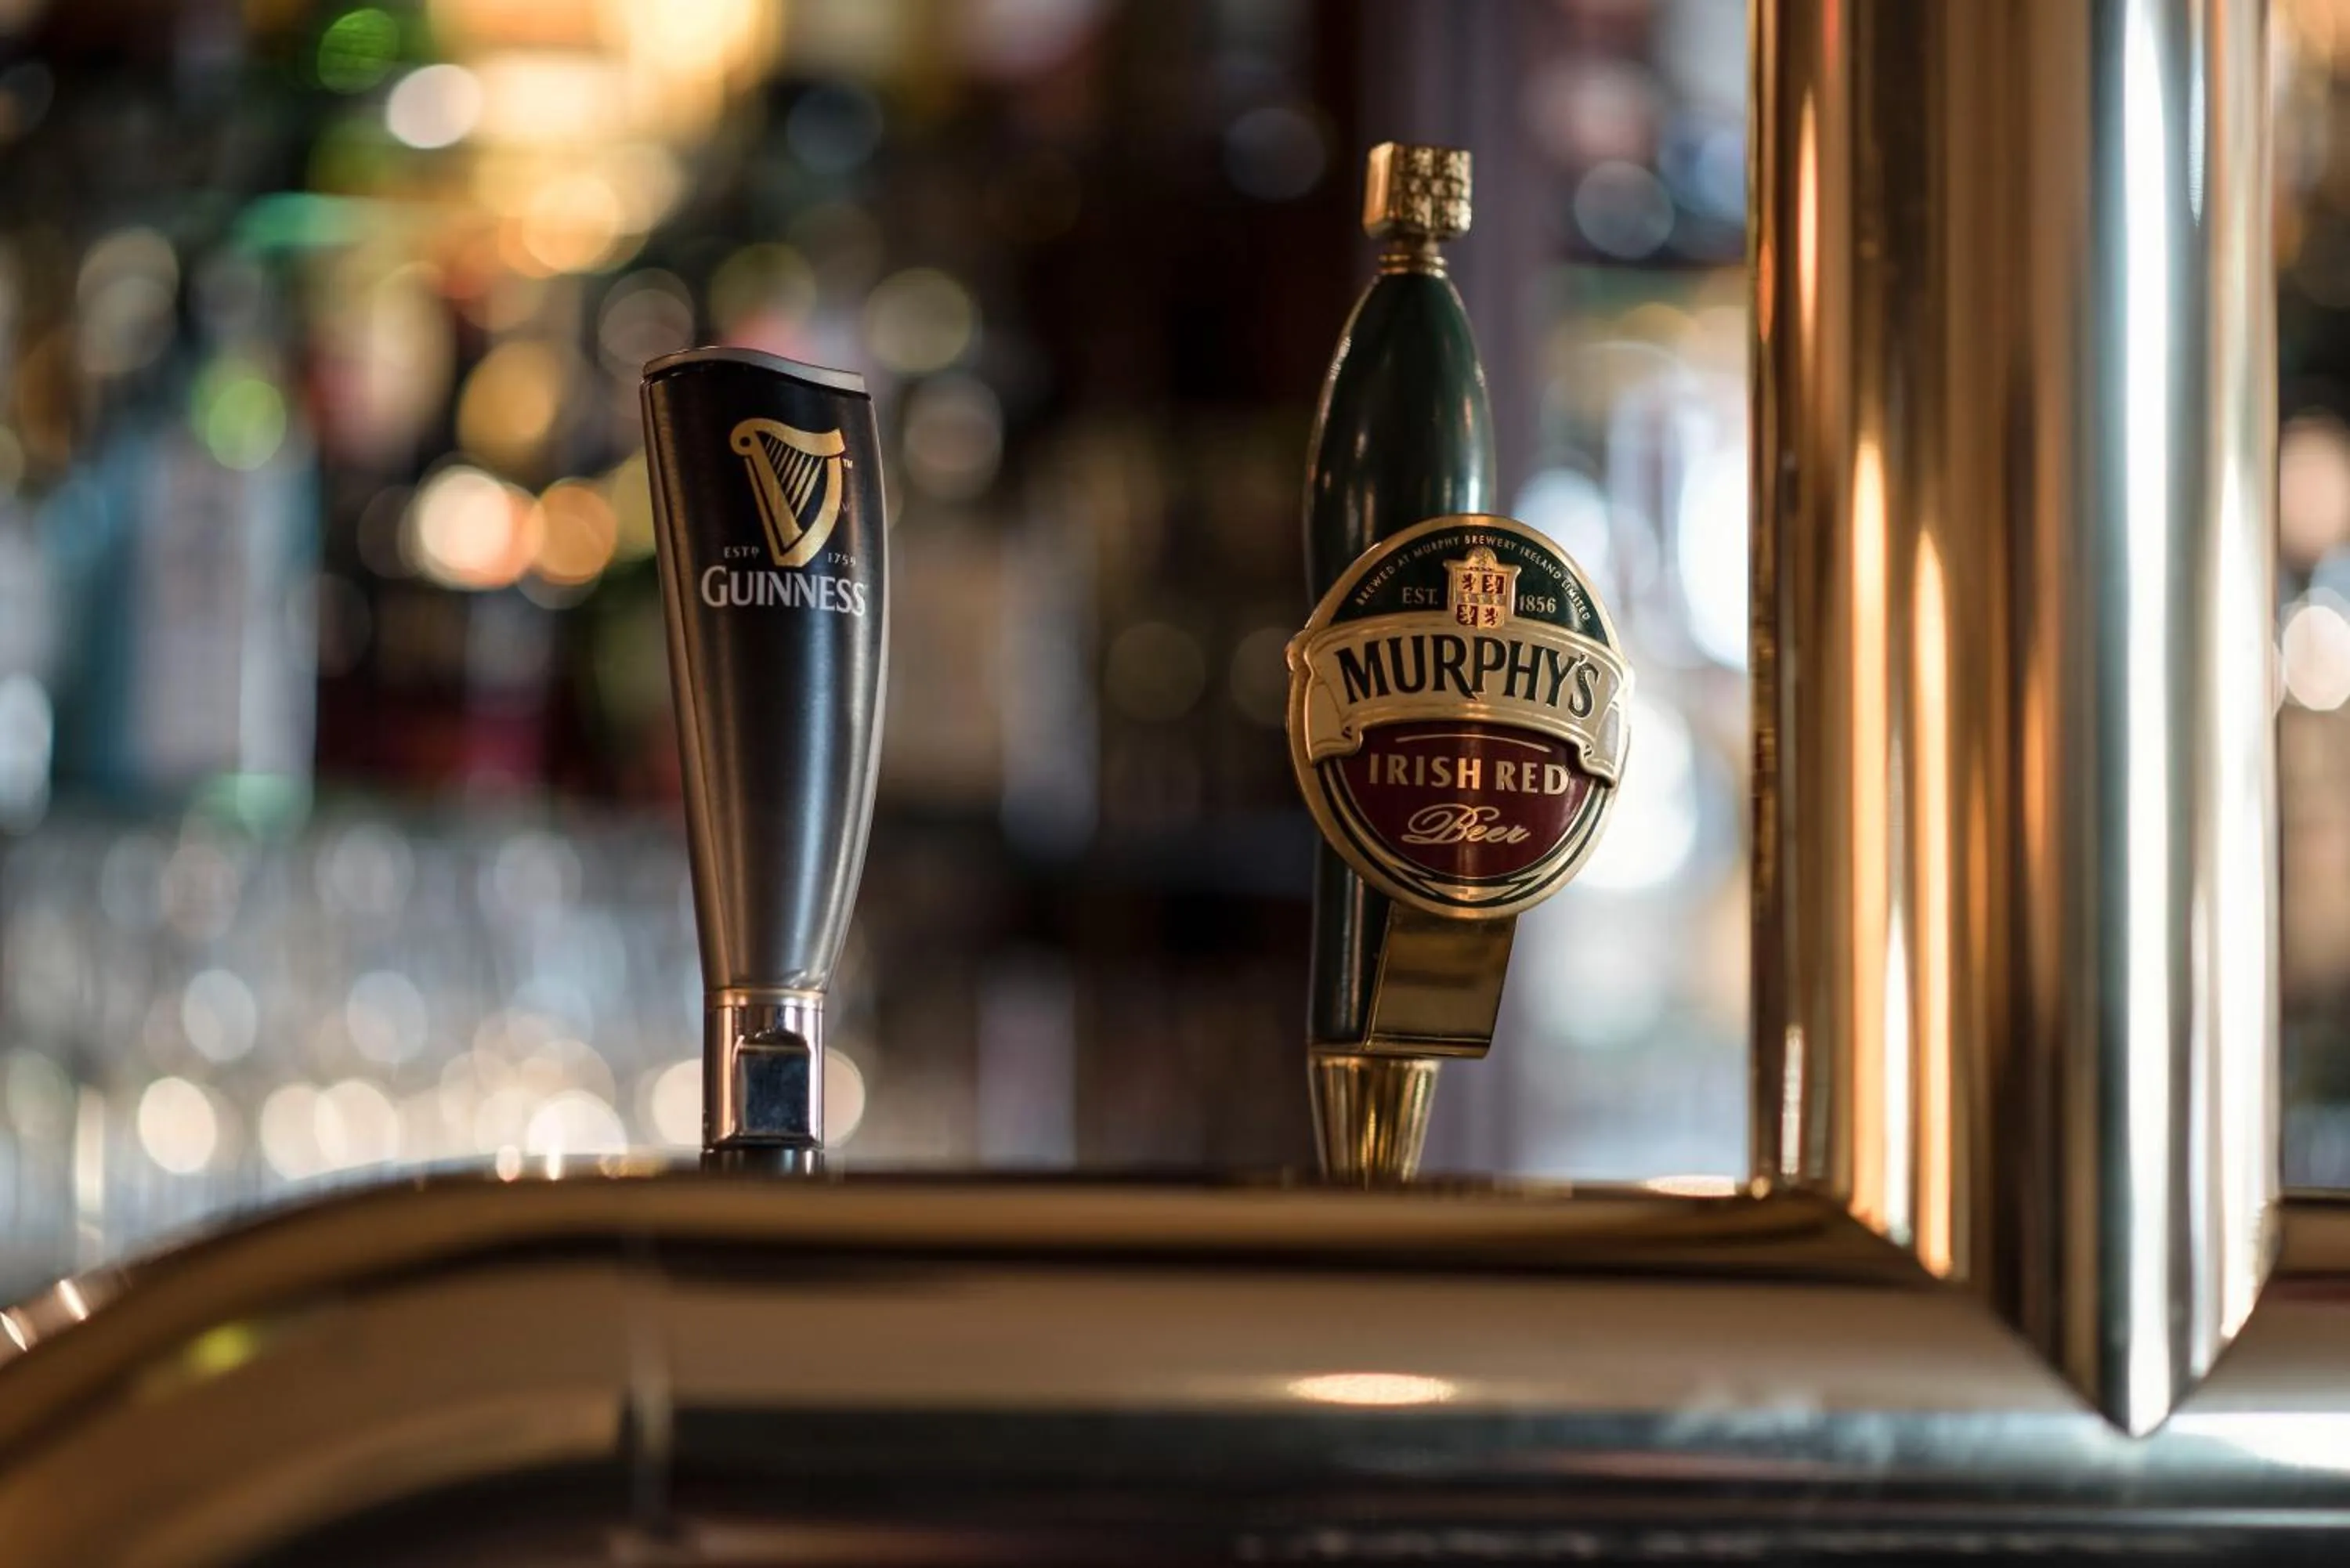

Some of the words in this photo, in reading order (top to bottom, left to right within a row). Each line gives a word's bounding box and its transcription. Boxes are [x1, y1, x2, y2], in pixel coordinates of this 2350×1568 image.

[828, 552, 856, 566] 1759
[1355, 565, 1395, 606] BREWED
[1397, 554, 1411, 567] AT
[1412, 536, 1459, 558] MURPHY
[1464, 535, 1518, 550] BREWERY
[1520, 545, 1561, 580] IRELAND
[1561, 578, 1591, 620] LIMITED
[701, 565, 866, 617] GUINNESS
[1402, 587, 1438, 605] EST.
[1518, 595, 1557, 614] 1856
[1335, 634, 1600, 720] MURPHY'S
[1369, 753, 1481, 790] IRISH
[1495, 761, 1569, 795] RED
[1401, 803, 1531, 844] Beer
